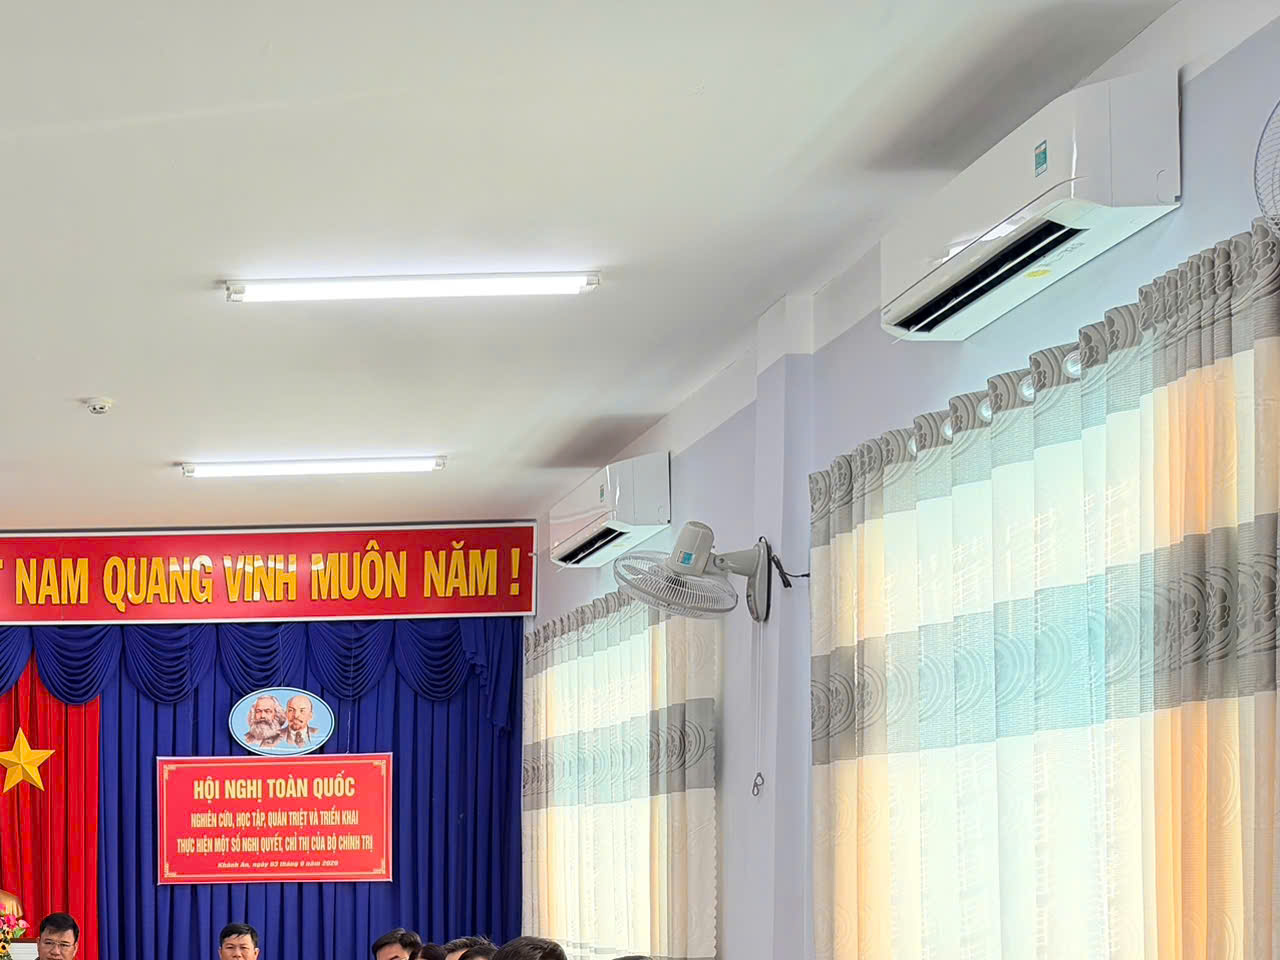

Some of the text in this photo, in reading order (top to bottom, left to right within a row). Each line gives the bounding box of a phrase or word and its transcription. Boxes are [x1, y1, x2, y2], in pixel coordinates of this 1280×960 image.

[16, 557, 89, 605] NAM
[103, 554, 214, 613] QUANG
[223, 553, 297, 602] VINH
[311, 539, 407, 600] MUÔN
[424, 539, 498, 597] NĂM
[510, 547, 520, 596] !
[193, 770, 356, 804] HỘI NGHỊ TOÀN QUỐC
[191, 809, 217, 828] NGHIÊN
[236, 812, 251, 830] HỌC
[288, 808, 308, 829] TRIỆT
[309, 808, 318, 826] VÀ
[341, 810, 359, 825] KHAI
[177, 837, 195, 856] THỰC
[196, 834, 213, 856] HIỆN
[214, 834, 230, 856] MỘT
[231, 832, 241, 853] SỐ
[242, 837, 260, 855] NGHỊ
[285, 831, 297, 852] CHỈ
[298, 836, 310, 854] THỊ
[311, 831, 325, 851] CỦA
[327, 832, 337, 854] BỘ
[338, 832, 360, 850] CHÍNH
[361, 835, 374, 853] TRỊ
